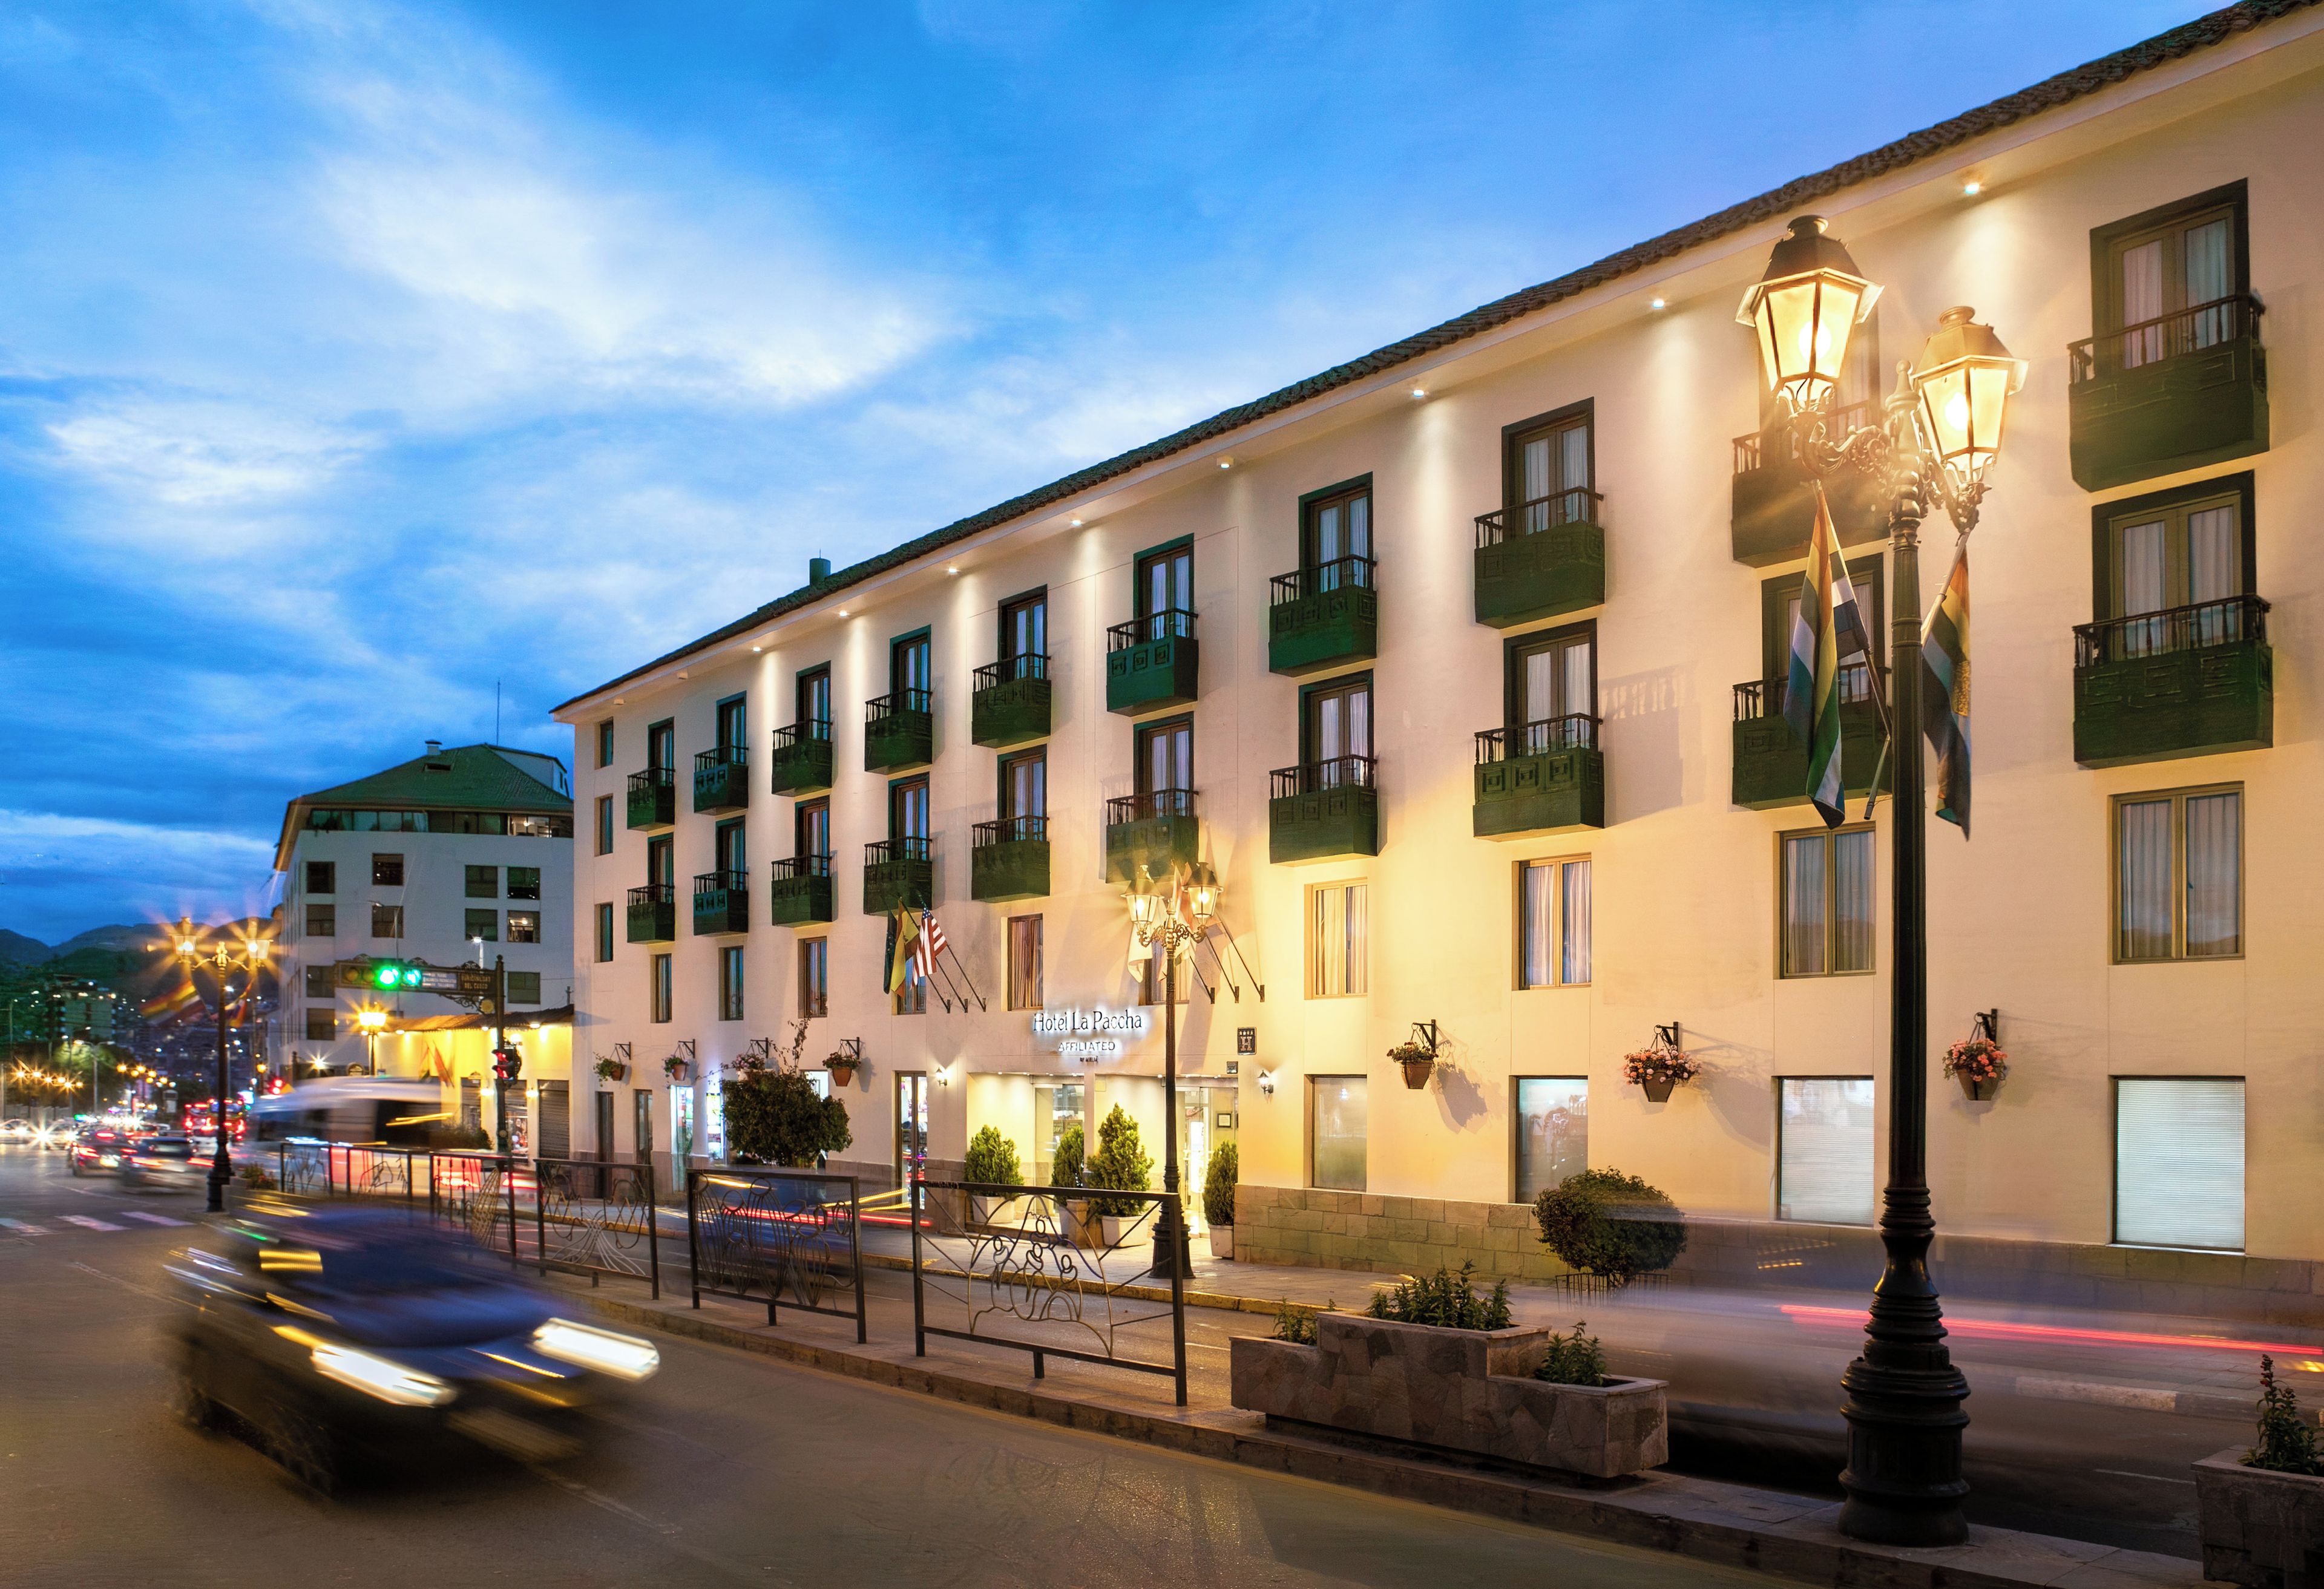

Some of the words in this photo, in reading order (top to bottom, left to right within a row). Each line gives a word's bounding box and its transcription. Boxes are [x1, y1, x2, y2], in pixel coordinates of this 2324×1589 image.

[1033, 1011, 1068, 1031] Hotel
[1072, 1011, 1089, 1030] La
[1093, 1009, 1143, 1030] Paccha
[1058, 1041, 1115, 1052] AFFILIATED
[1240, 1036, 1252, 1051] H
